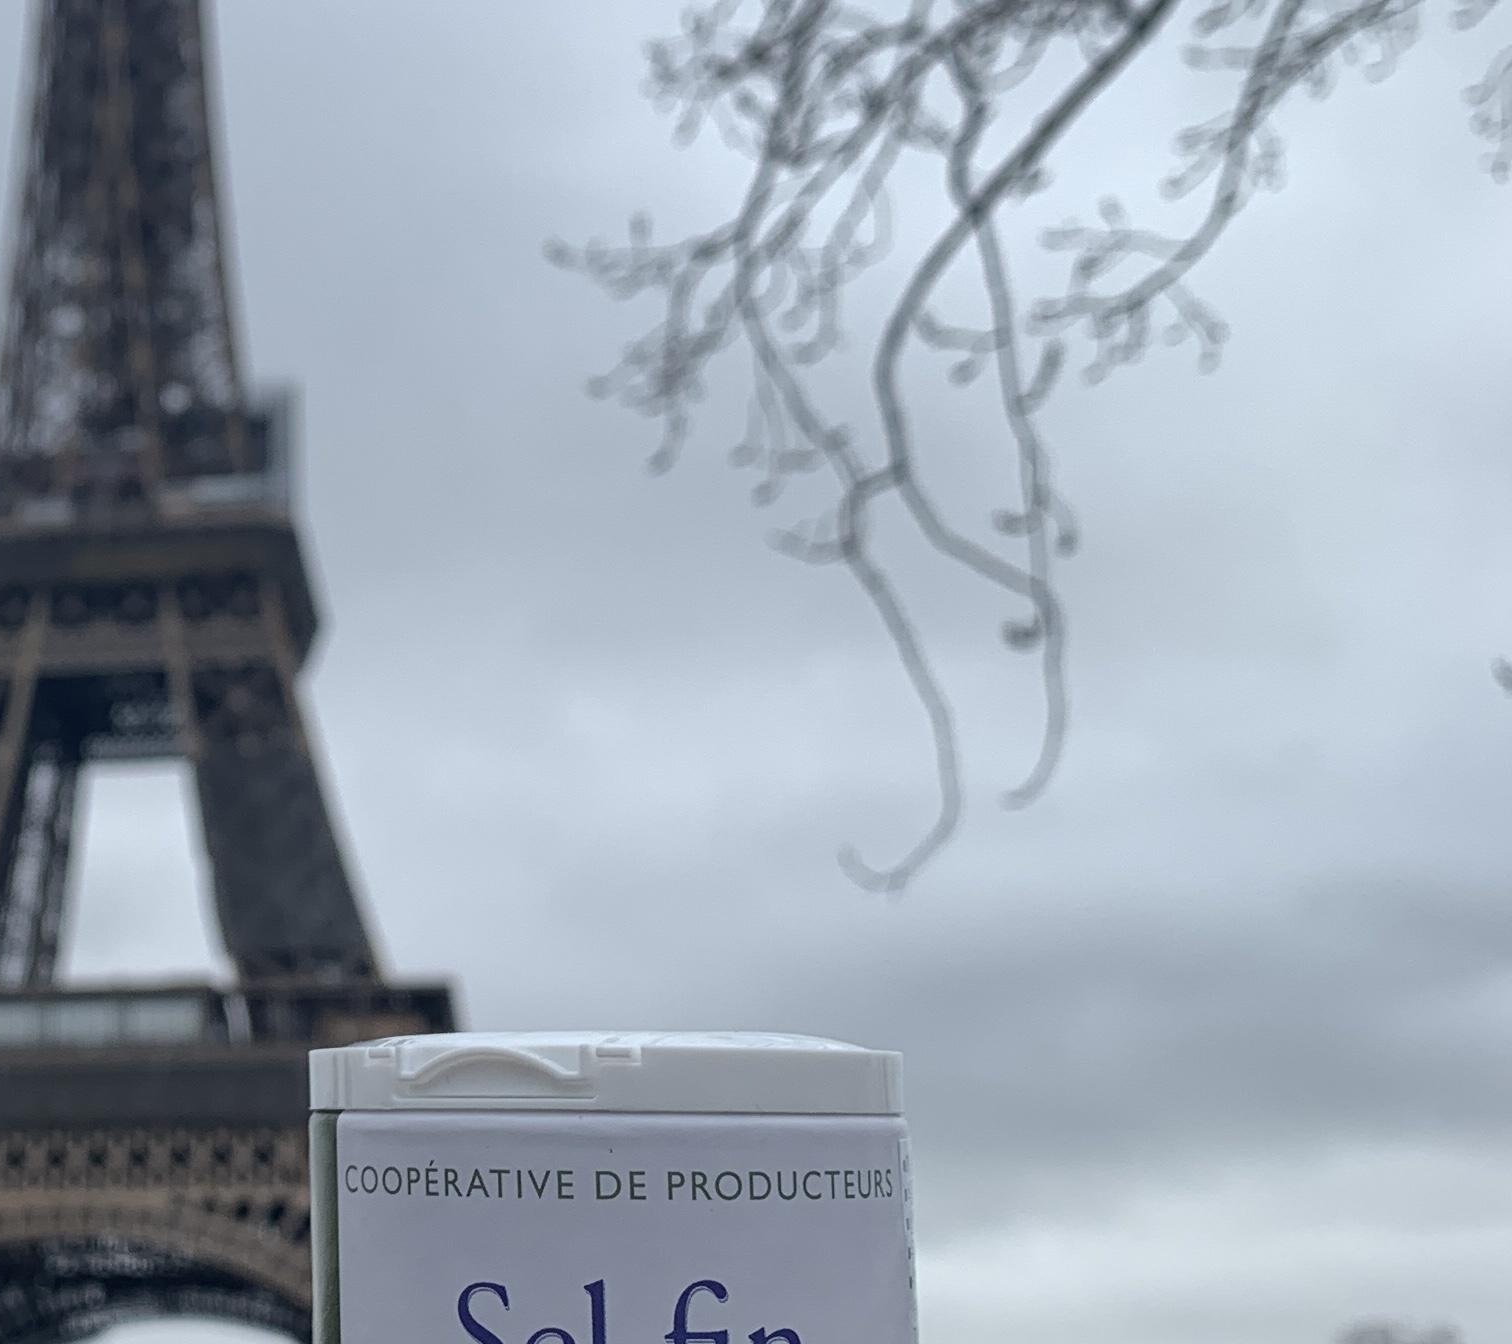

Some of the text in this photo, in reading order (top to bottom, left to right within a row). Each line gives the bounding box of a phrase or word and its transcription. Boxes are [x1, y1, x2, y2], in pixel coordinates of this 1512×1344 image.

[345, 1159, 894, 1202] COOPÉRATIVE DE PRODUCTEURS
